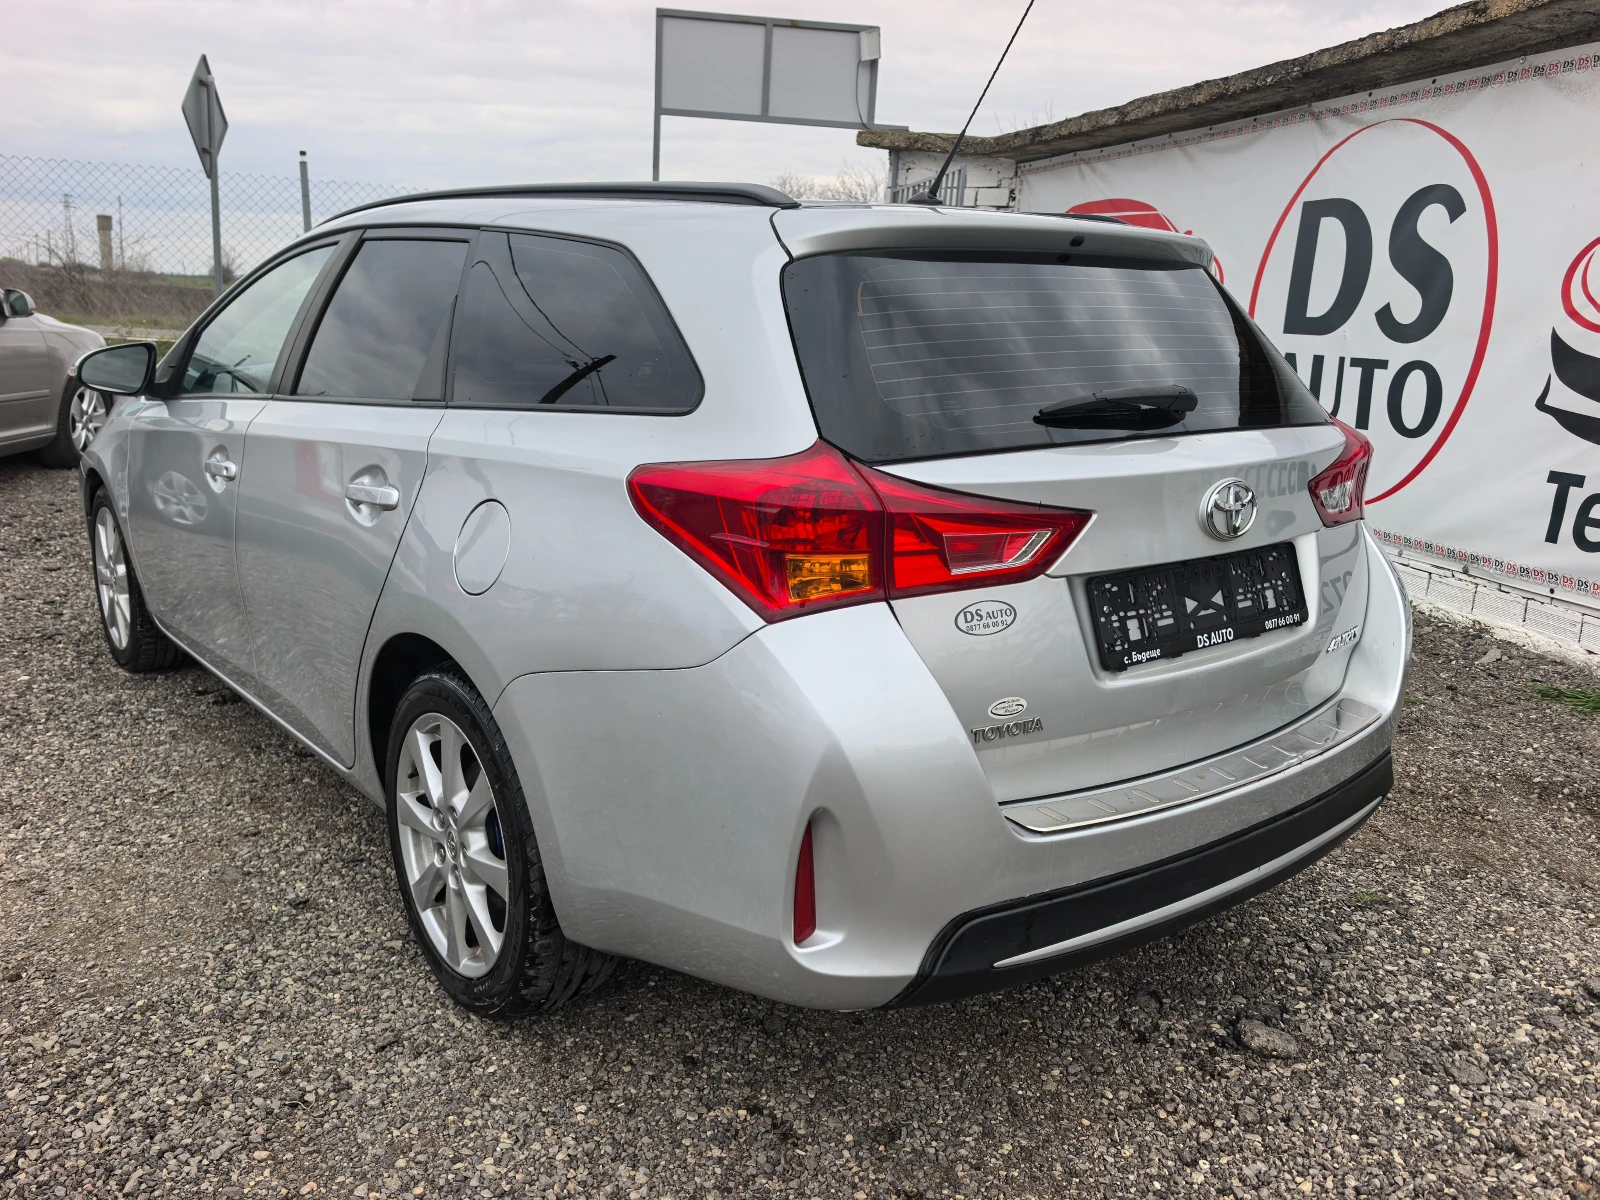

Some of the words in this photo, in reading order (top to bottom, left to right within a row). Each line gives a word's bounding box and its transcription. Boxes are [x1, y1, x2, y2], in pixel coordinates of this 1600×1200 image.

[1494, 73, 1503, 81] DS
[1508, 70, 1517, 79] DS
[1521, 68, 1530, 76] DS
[1534, 65, 1545, 73] DS
[1549, 63, 1559, 71] DS
[1563, 60, 1574, 68] DS
[1579, 57, 1589, 66] DS
[1283, 184, 1467, 344] DS
[1284, 353, 1443, 439] UTO
[1495, 560, 1503, 568] DS
[1548, 573, 1558, 581] DS
[1563, 576, 1574, 584] DS
[1578, 580, 1588, 588] DS
[963, 608, 983, 624] DS
[986, 608, 1012, 620] AUTO
[1265, 619, 1277, 630] 0877
[1278, 617, 1286, 627] 66
[1286, 616, 1293, 625] 00
[1294, 613, 1300, 622] 91
[1197, 634, 1209, 648] DS
[1210, 628, 1234, 645] AUTO
[1132, 648, 1161, 663] Бъдеще
[971, 717, 1043, 743] TOYOTA
